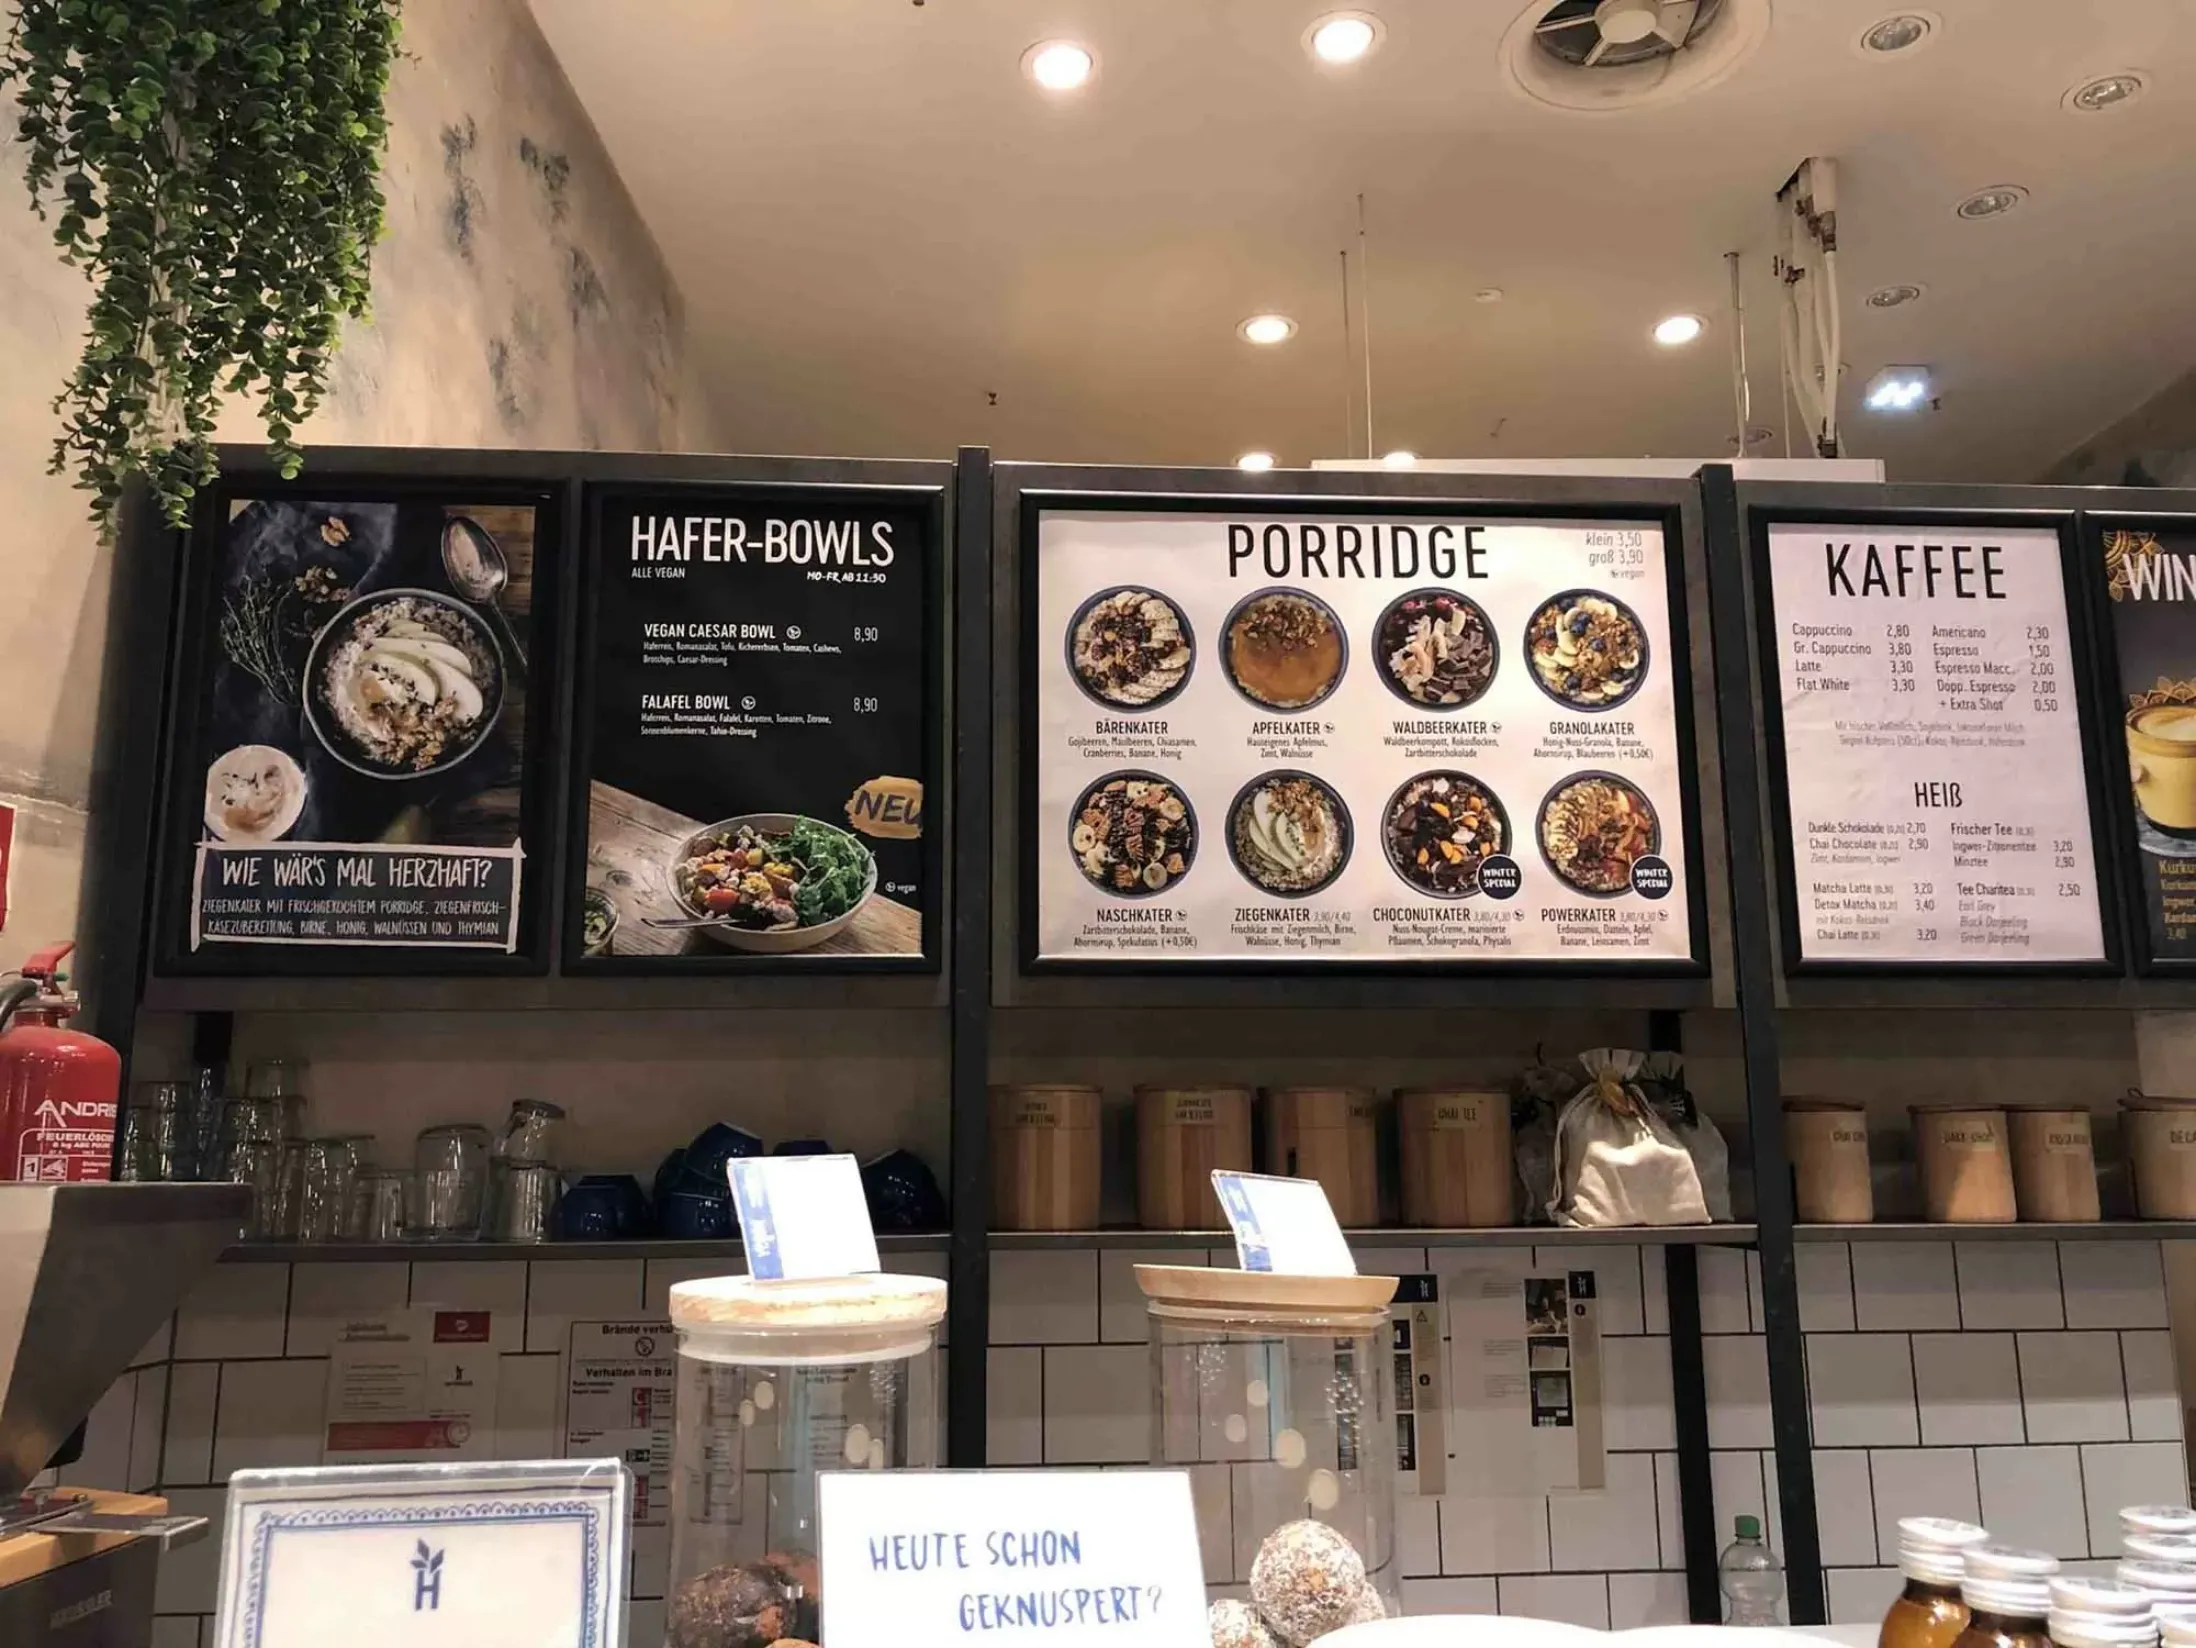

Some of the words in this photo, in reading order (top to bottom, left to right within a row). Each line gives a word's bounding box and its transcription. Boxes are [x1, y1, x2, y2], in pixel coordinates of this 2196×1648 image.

[631, 515, 895, 567] HAFER-BOWLS
[1585, 531, 1613, 546] klein
[1616, 531, 1642, 548] 3,50
[1228, 524, 1489, 579] PORRIDGE
[1589, 549, 1614, 567] groß
[1618, 549, 1644, 566] 3,90
[631, 567, 652, 579] ALLE
[655, 567, 686, 579] VEGAN
[1825, 543, 2007, 599] KAFFEE
[644, 623, 685, 638] VEGAN
[689, 623, 737, 638] CAESAR
[740, 624, 776, 639] BOWL
[853, 626, 879, 643] 8,90
[1792, 622, 1852, 638] Cappuccino
[1886, 624, 1910, 639] 2,80
[1932, 624, 1986, 638] Americano
[2026, 626, 2049, 641] 2,30
[1793, 641, 1809, 654] Gr.
[1811, 641, 1872, 656] Cappuccino
[1888, 642, 1912, 656] 3,80
[1933, 642, 1979, 657] Espresso
[2029, 644, 2050, 659] 1,50
[1795, 659, 1821, 672] Latte
[1890, 660, 1914, 674] 3,30
[1935, 660, 1980, 676] Espresso
[1983, 661, 2016, 675] Macc.
[2030, 662, 2054, 677] 2,00
[1796, 677, 1818, 690] Flat
[1819, 678, 1850, 691] White
[1892, 678, 1915, 693] 3,30
[1937, 679, 1968, 694] Dopp.
[1970, 679, 2016, 694] Espresso
[2032, 680, 2056, 695] 2,00
[641, 695, 691, 710] FALAFEL
[695, 695, 730, 710] BOWL
[853, 697, 878, 714] 8,90
[1950, 697, 1977, 710] Extra
[1979, 697, 2004, 711] Shot
[2034, 698, 2058, 712] 0,50
[1096, 718, 1168, 734] BÄRENKATER
[1252, 721, 1320, 735] APFELKATER
[1392, 721, 1487, 734] WALDBEERKATER
[1549, 721, 1635, 735] GRANOLAKATER
[1808, 821, 1837, 834] Dunkle
[1838, 821, 1885, 834] Schokolade
[1907, 822, 1926, 835] 2,70
[1951, 822, 1992, 835] Frischer
[1994, 822, 2012, 836] Tee
[1809, 837, 1829, 850] Chai
[1832, 837, 1877, 850] Chocolate
[1908, 838, 1929, 851] 2,90
[2053, 840, 2073, 853] 3,20
[222, 857, 262, 886] WIE
[273, 853, 326, 887] WÄR'S
[337, 857, 376, 887] MAL
[389, 857, 493, 888] HERZHAFT?
[1483, 868, 1516, 879] WINTER
[1636, 868, 1668, 879] WINTER
[897, 883, 917, 894] vegan
[1483, 877, 1516, 888] SPECIAL
[1636, 877, 1669, 889] SPECIAL
[1813, 882, 1847, 894] Matcha
[1849, 883, 1872, 894] Latte
[1913, 882, 1933, 895] 3,20
[1957, 882, 1974, 896] Tee
[2058, 883, 2081, 897] 2,50
[202, 899, 262, 914] ZIEGENKATER
[267, 899, 284, 914] MIT
[1814, 898, 1840, 910] Detox
[1842, 898, 1876, 910] Matcha
[1915, 899, 1935, 912] 3,40
[1097, 908, 1173, 922] NASCHKATER
[1235, 908, 1310, 922] ZIEGENKATER
[1373, 907, 1471, 921] CHOCONUTKATER
[1541, 908, 1616, 922] POWERKATER
[432, 921, 452, 935] UND
[458, 921, 499, 936] THYMIAN
[1817, 928, 1836, 940] Chai
[1838, 928, 1859, 940] Latte
[1917, 928, 1937, 941] 3,20
[602, 1324, 640, 1335] Brände
[586, 1367, 636, 1377] Verhalten
[638, 1367, 652, 1377] im
[654, 1367, 672, 1377] Bra
[869, 1532, 971, 1571] HEUTE
[985, 1530, 1082, 1567] SCHON
